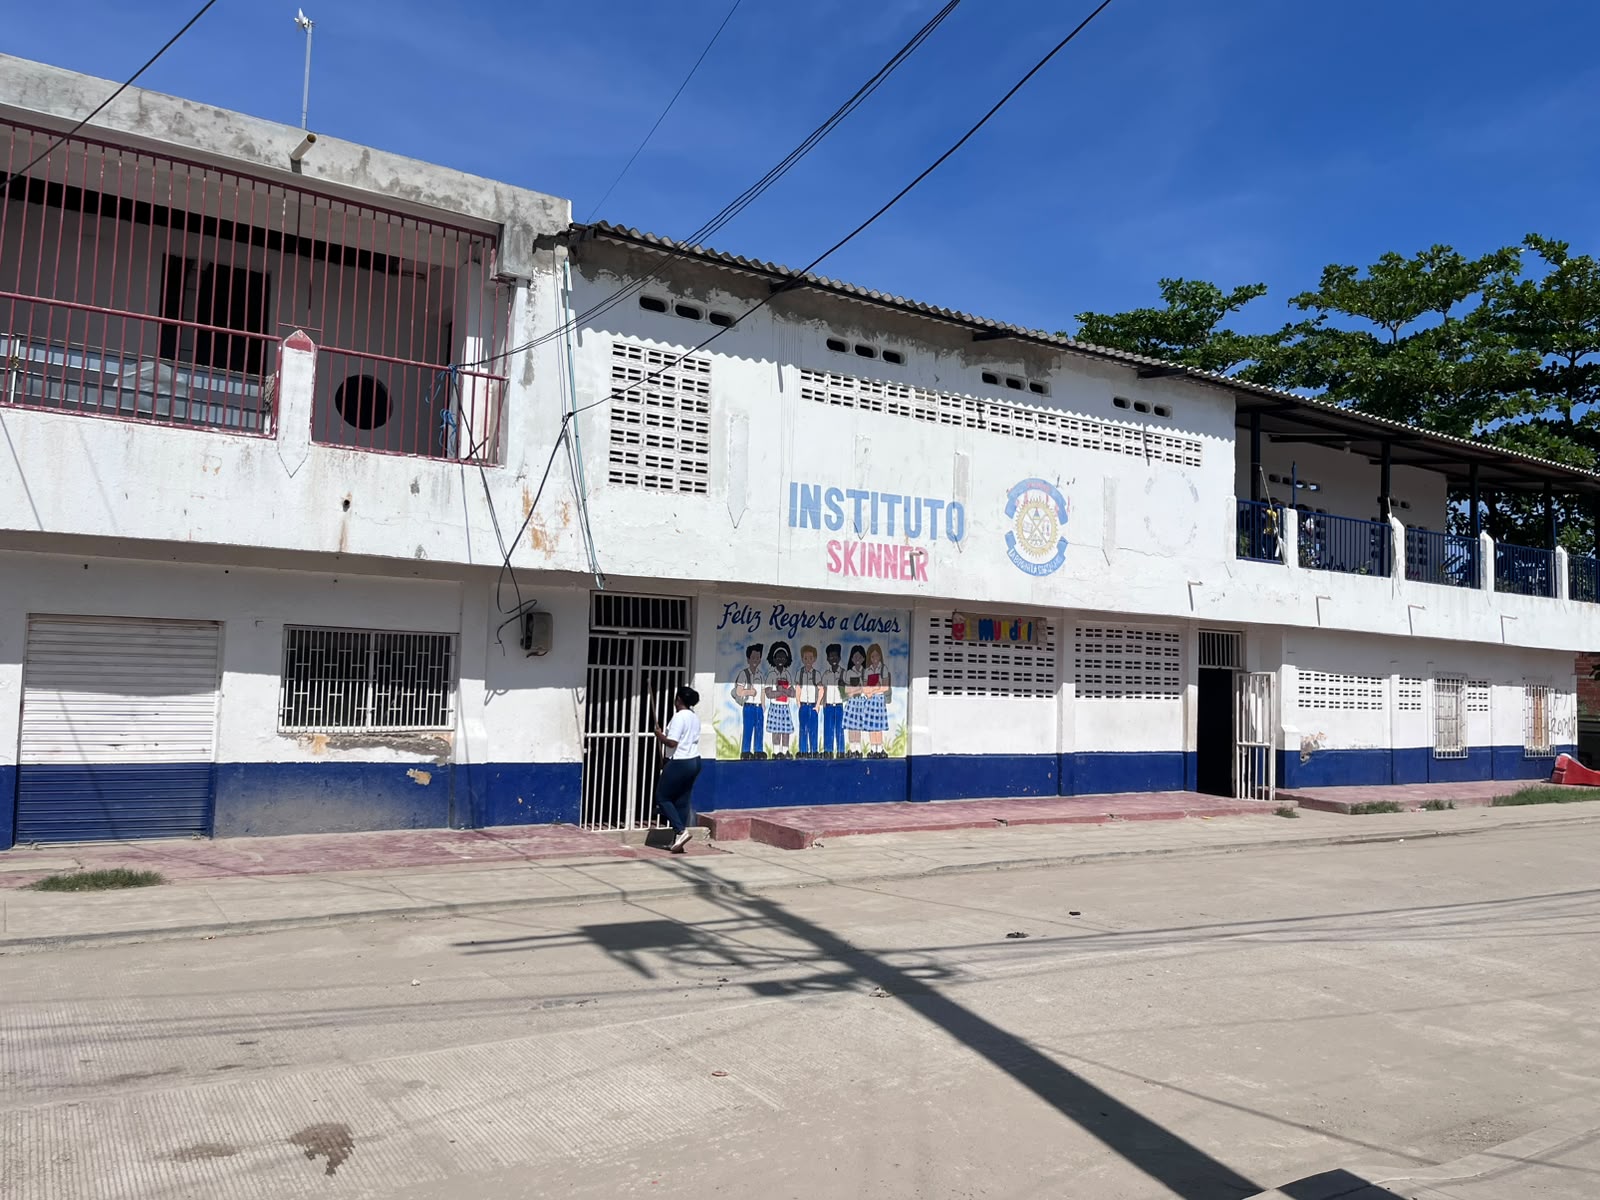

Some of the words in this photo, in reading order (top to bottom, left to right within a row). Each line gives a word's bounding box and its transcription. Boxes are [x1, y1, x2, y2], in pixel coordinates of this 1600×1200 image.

[788, 481, 966, 543] INSTITUTO
[826, 539, 930, 583] SKINNER
[716, 601, 762, 633] Feliz
[768, 603, 838, 639] Regreso
[839, 617, 849, 631] a
[853, 611, 902, 633] Clases
